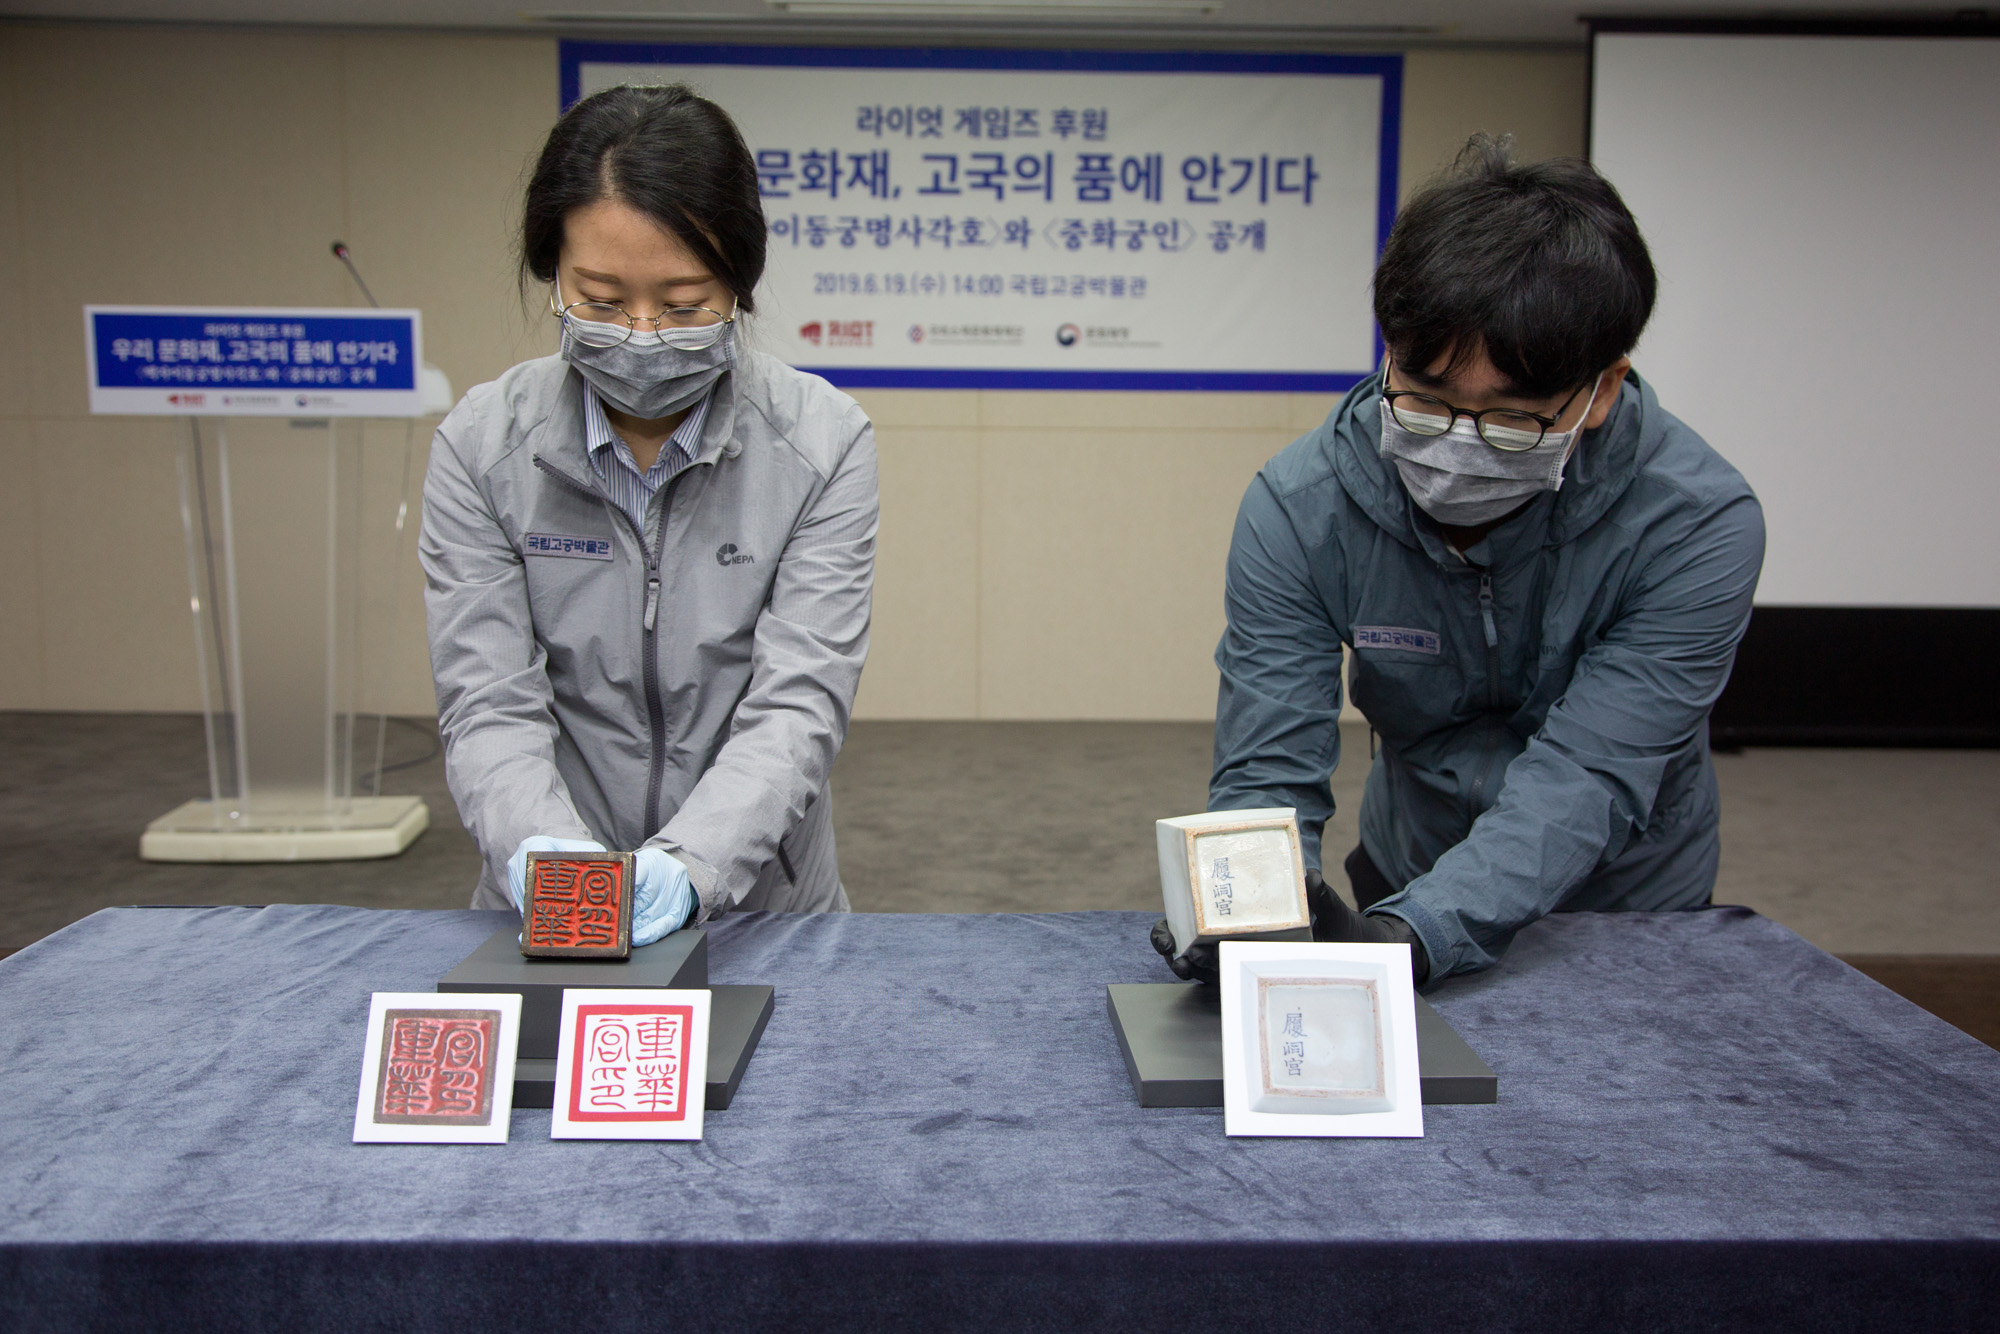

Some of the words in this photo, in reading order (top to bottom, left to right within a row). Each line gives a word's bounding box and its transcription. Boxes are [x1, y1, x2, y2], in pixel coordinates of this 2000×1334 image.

[856, 105, 944, 139] 라이엇
[953, 106, 1041, 141] 게임즈
[1052, 107, 1108, 142] 후원
[756, 148, 902, 200] 문화재,
[917, 151, 1055, 202] 고국의
[1072, 152, 1163, 204] 품에
[1180, 153, 1320, 206] 안기다
[769, 213, 1033, 250] 이동궁명사각호〉와
[1206, 218, 1268, 253] 공개
[953, 273, 1005, 295] 14:00
[1009, 273, 1147, 298] 국립고궁박물관
[111, 338, 154, 362] 우리
[158, 338, 225, 363] 문화재,
[227, 339, 289, 364] 고국의
[336, 340, 399, 365] 안기다
[528, 537, 610, 555] 국립고궁박물관
[731, 555, 755, 565] NEPA
[1359, 631, 1437, 650] 국립고궁박물관
